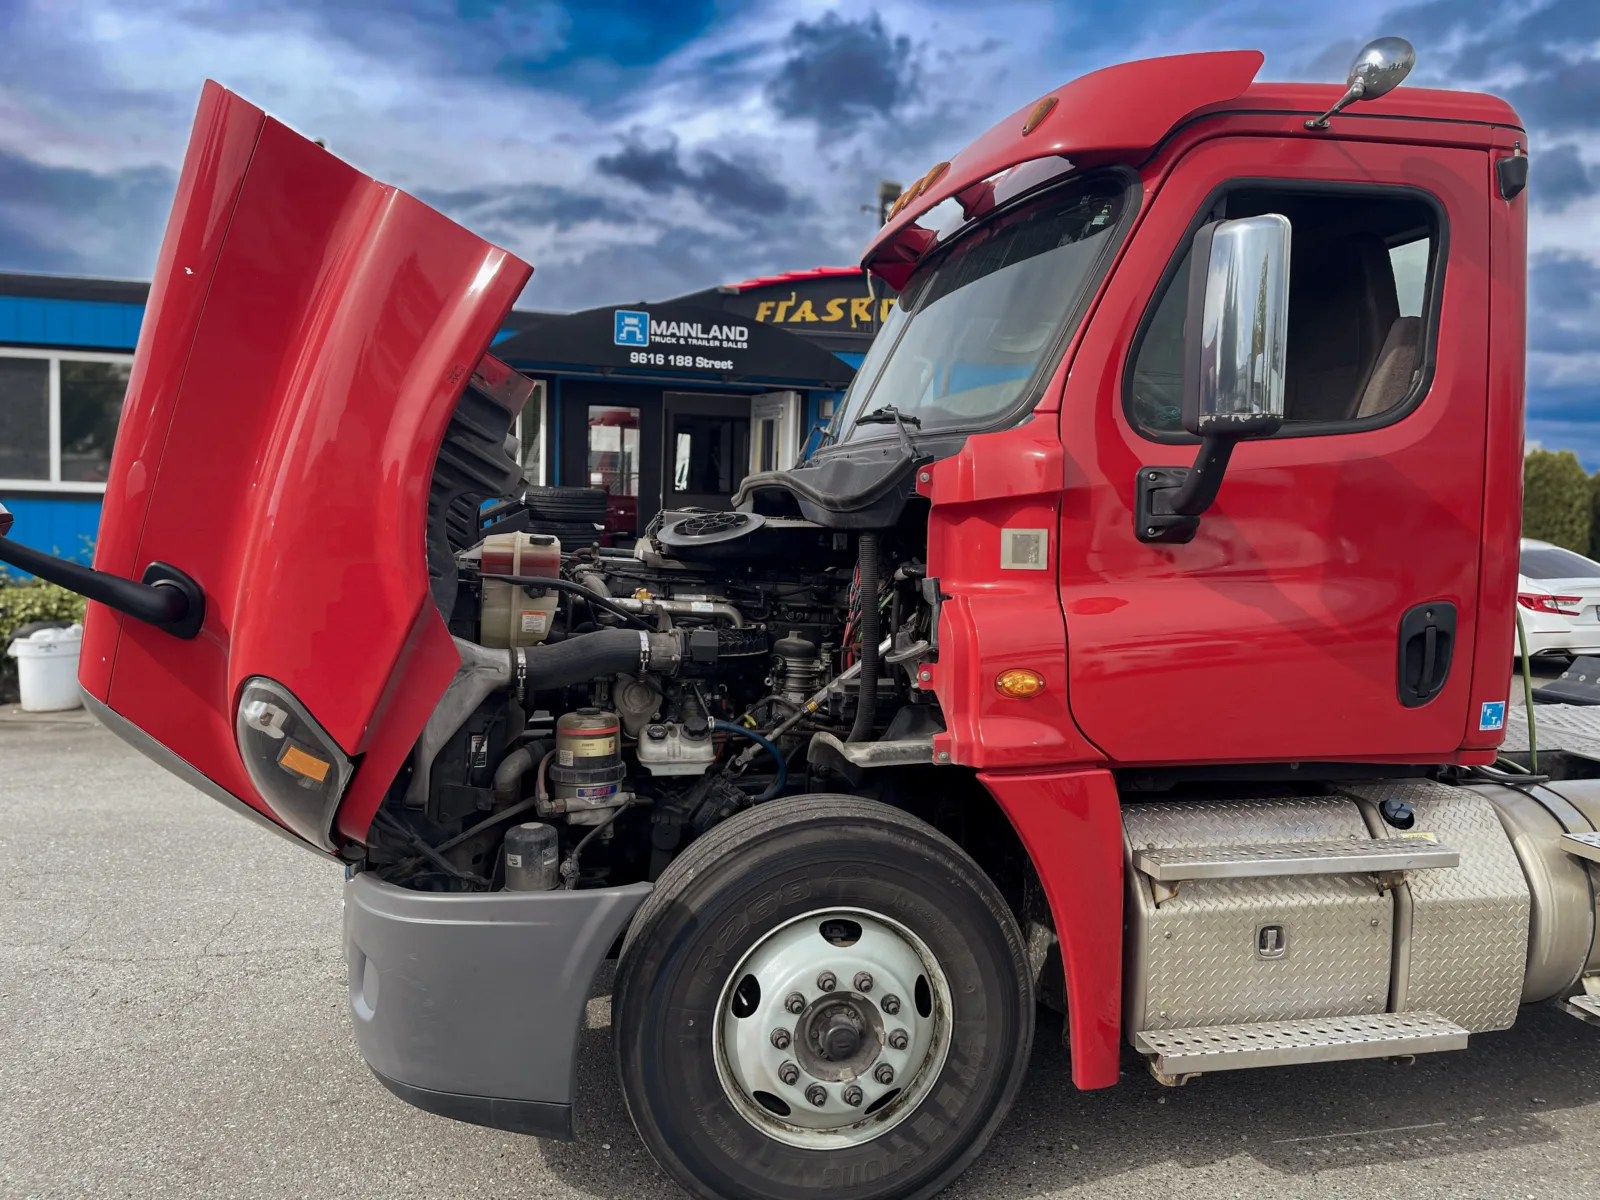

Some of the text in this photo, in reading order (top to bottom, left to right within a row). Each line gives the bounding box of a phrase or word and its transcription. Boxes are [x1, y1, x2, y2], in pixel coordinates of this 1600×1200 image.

[650, 320, 749, 341] MAINLAND
[650, 336, 748, 349] TRUCK & TRAILER SALES
[630, 352, 734, 370] 9616 188 Street
